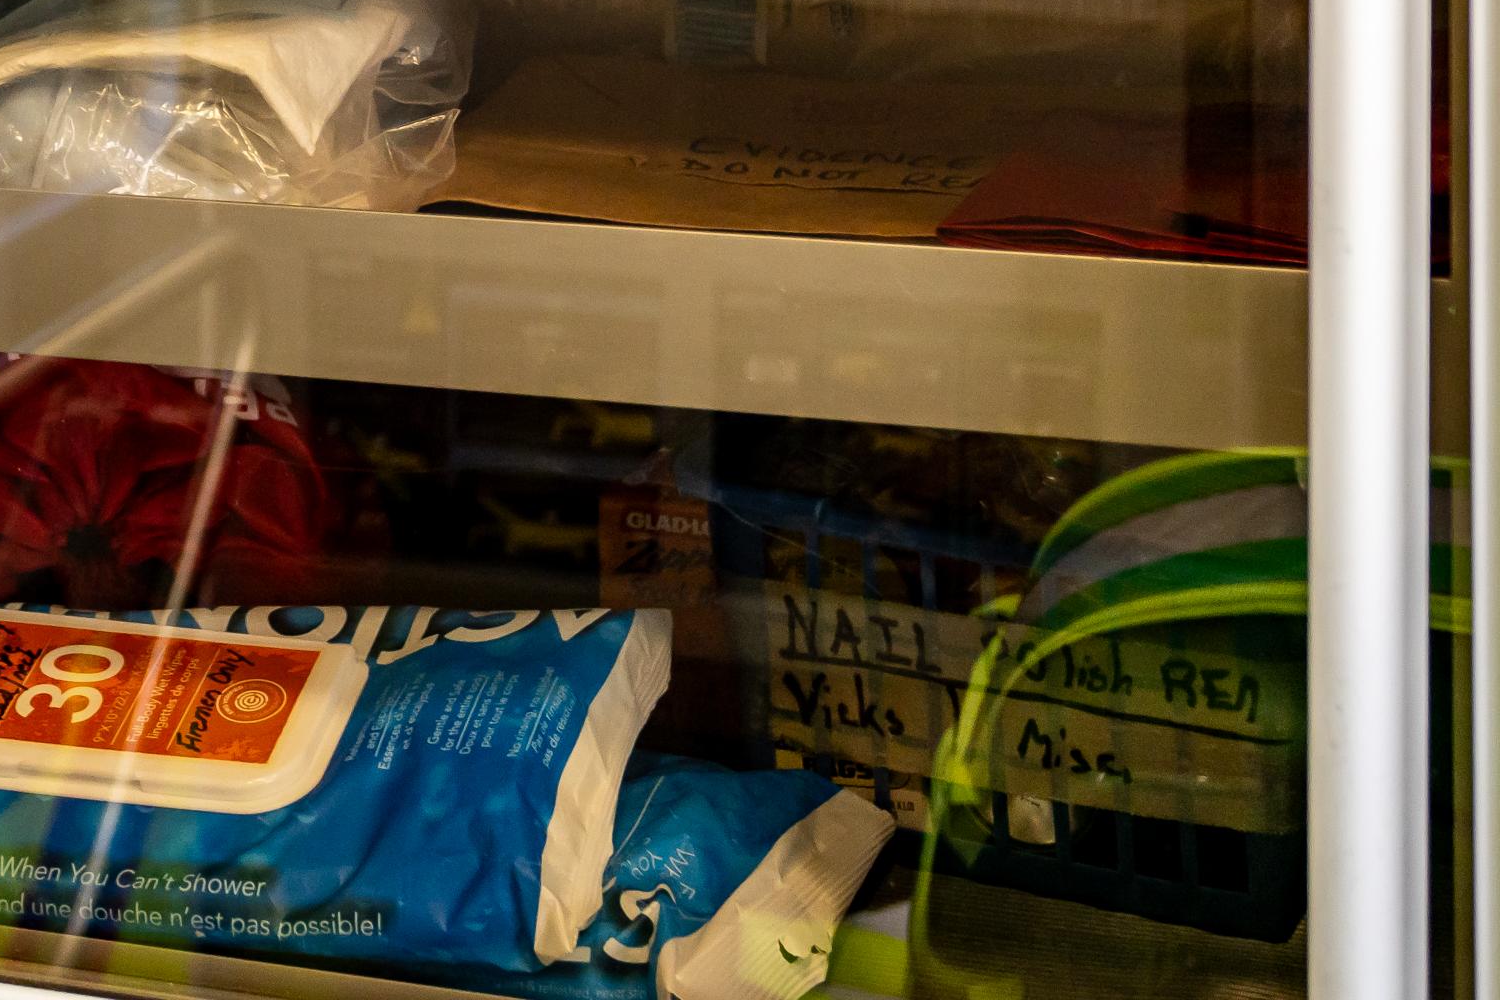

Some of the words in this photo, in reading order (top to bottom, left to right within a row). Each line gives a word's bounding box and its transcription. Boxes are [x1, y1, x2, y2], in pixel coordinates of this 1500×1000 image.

[683, 158, 749, 174] DO
[773, 165, 871, 181] NOT
[689, 137, 984, 170] EVIDENCE
[781, 595, 942, 673] NAIL
[15, 644, 125, 724] 30
[126, 694, 160, 743] Full-Body
[154, 676, 171, 700] Wet
[165, 649, 186, 677] Wipes
[146, 700, 176, 739] lingettes
[182, 658, 201, 682] corps
[176, 690, 222, 753] Firemen
[208, 648, 255, 685] Only
[782, 671, 905, 738] Vicks
[458, 694, 473, 719] entire
[427, 714, 448, 744] Gentle
[0, 855, 62, 882] When
[69, 862, 109, 886] You
[115, 868, 175, 891] Can't
[179, 873, 267, 897] Shower
[631, 848, 663, 880] YOU
[31, 902, 73, 917] une
[79, 898, 163, 926] douche
[169, 906, 224, 932] n'est
[231, 916, 271, 938] pas
[277, 911, 383, 941] possible!
